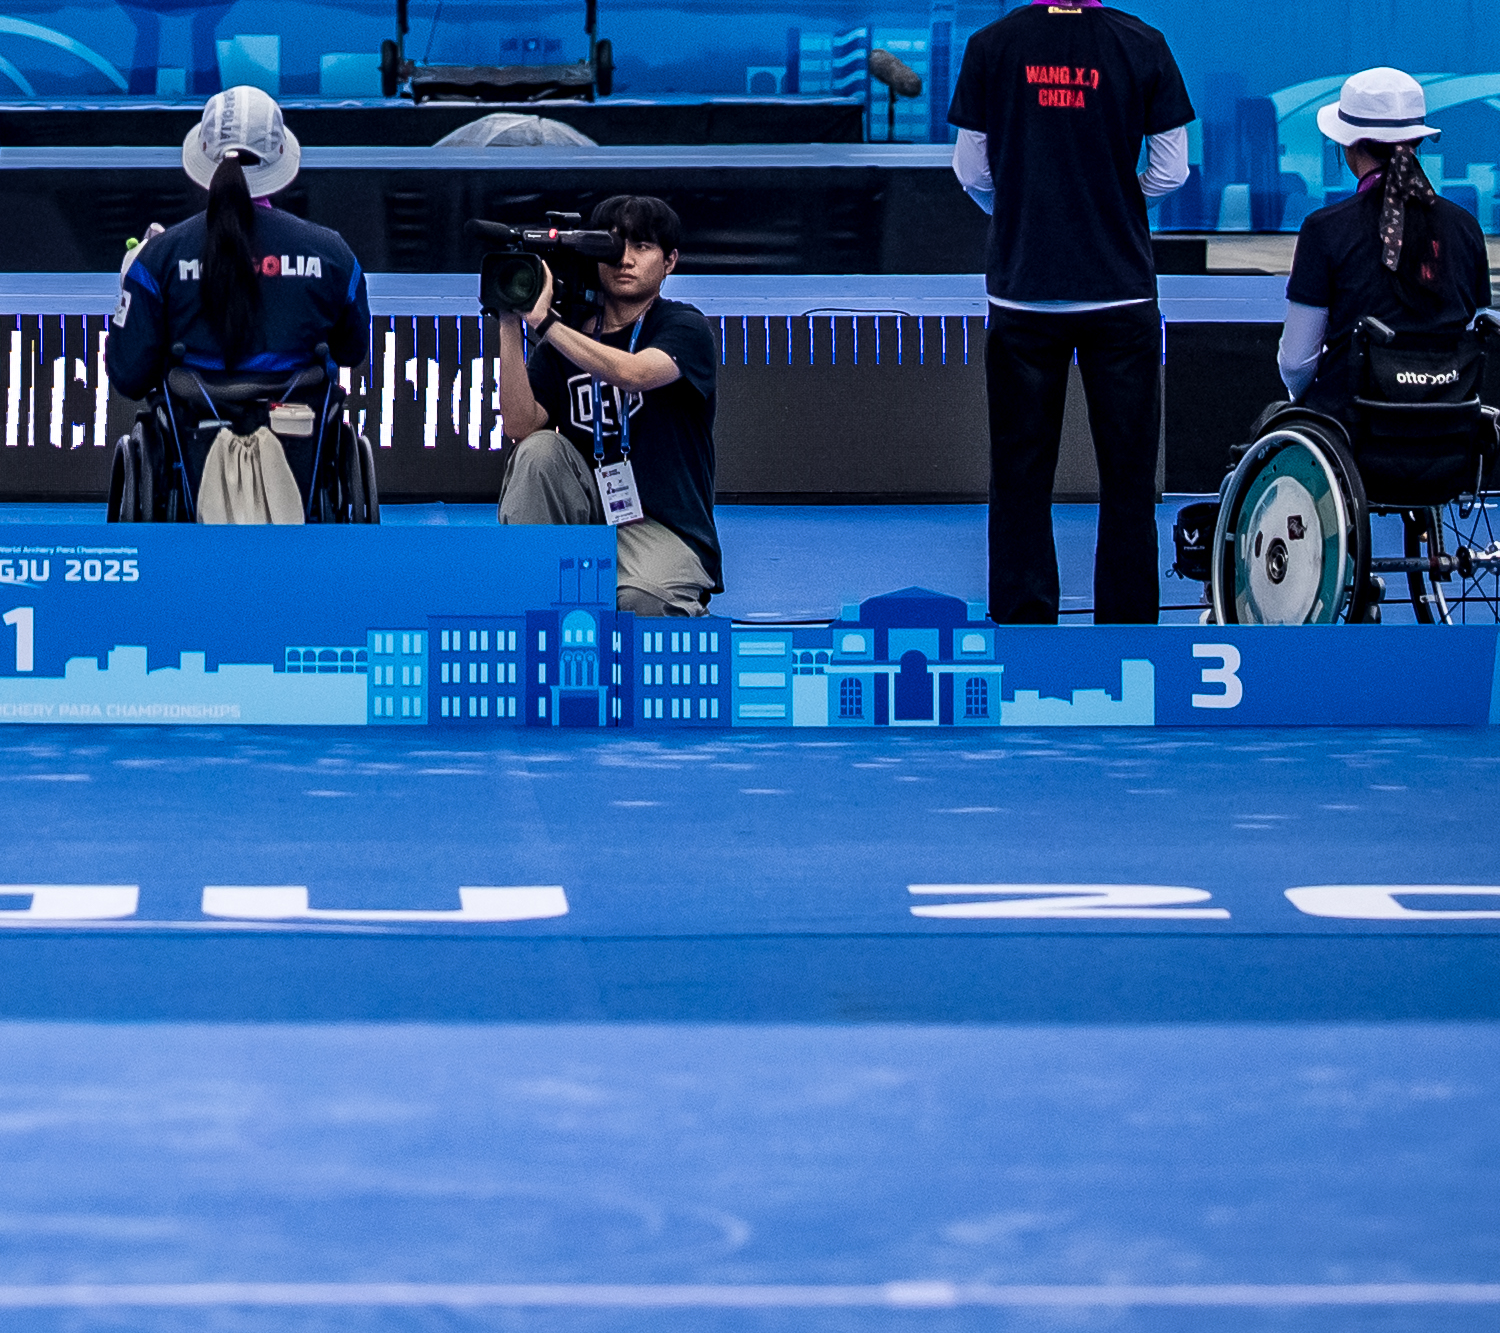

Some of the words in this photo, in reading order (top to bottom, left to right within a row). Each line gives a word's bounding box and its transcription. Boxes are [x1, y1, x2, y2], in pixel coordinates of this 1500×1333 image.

[178, 255, 323, 281] MOLIA
[65, 559, 140, 583] 2025
[0, 606, 35, 673] 1
[1191, 643, 1245, 710] 3
[58, 703, 102, 719] PARA
[105, 703, 241, 720] CHAMPIONSHIPS
